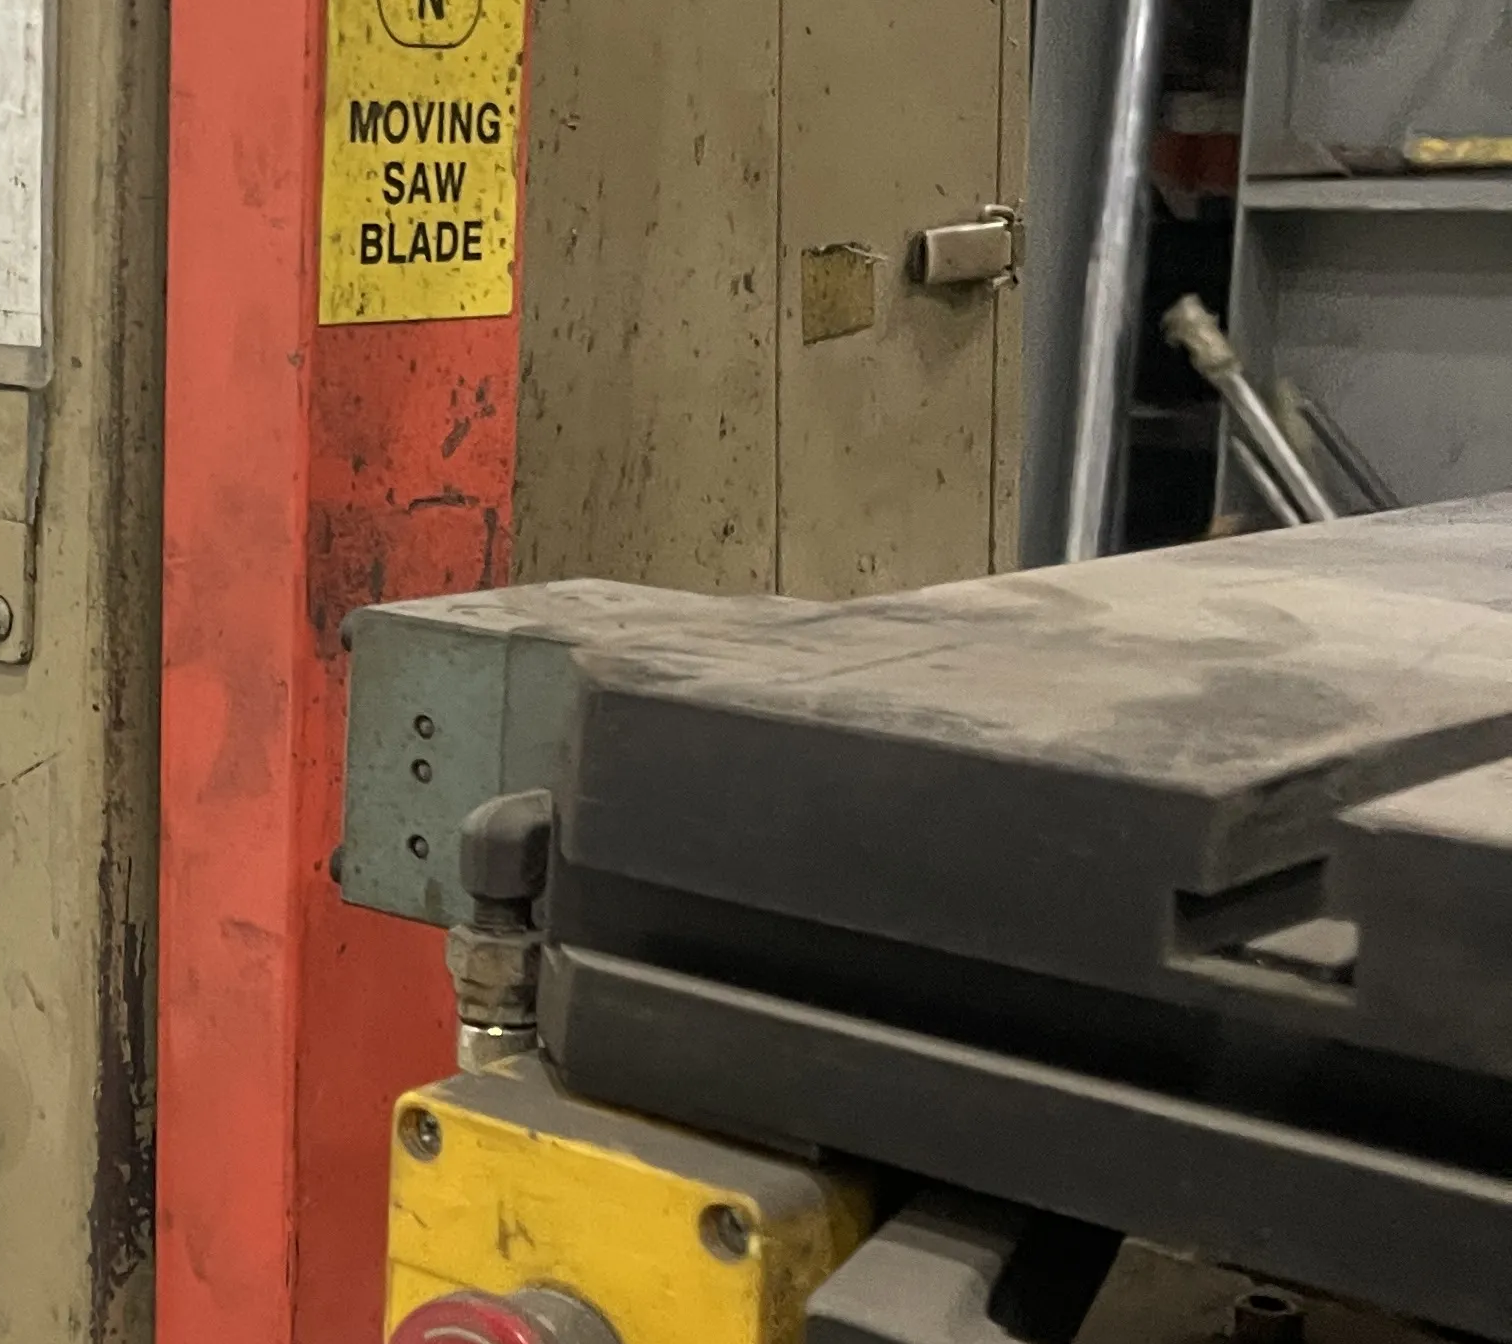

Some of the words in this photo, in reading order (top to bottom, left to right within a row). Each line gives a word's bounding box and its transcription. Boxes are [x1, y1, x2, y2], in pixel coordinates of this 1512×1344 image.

[348, 100, 502, 146] MOVING
[382, 161, 467, 205] SAW
[359, 220, 483, 266] BLADE
